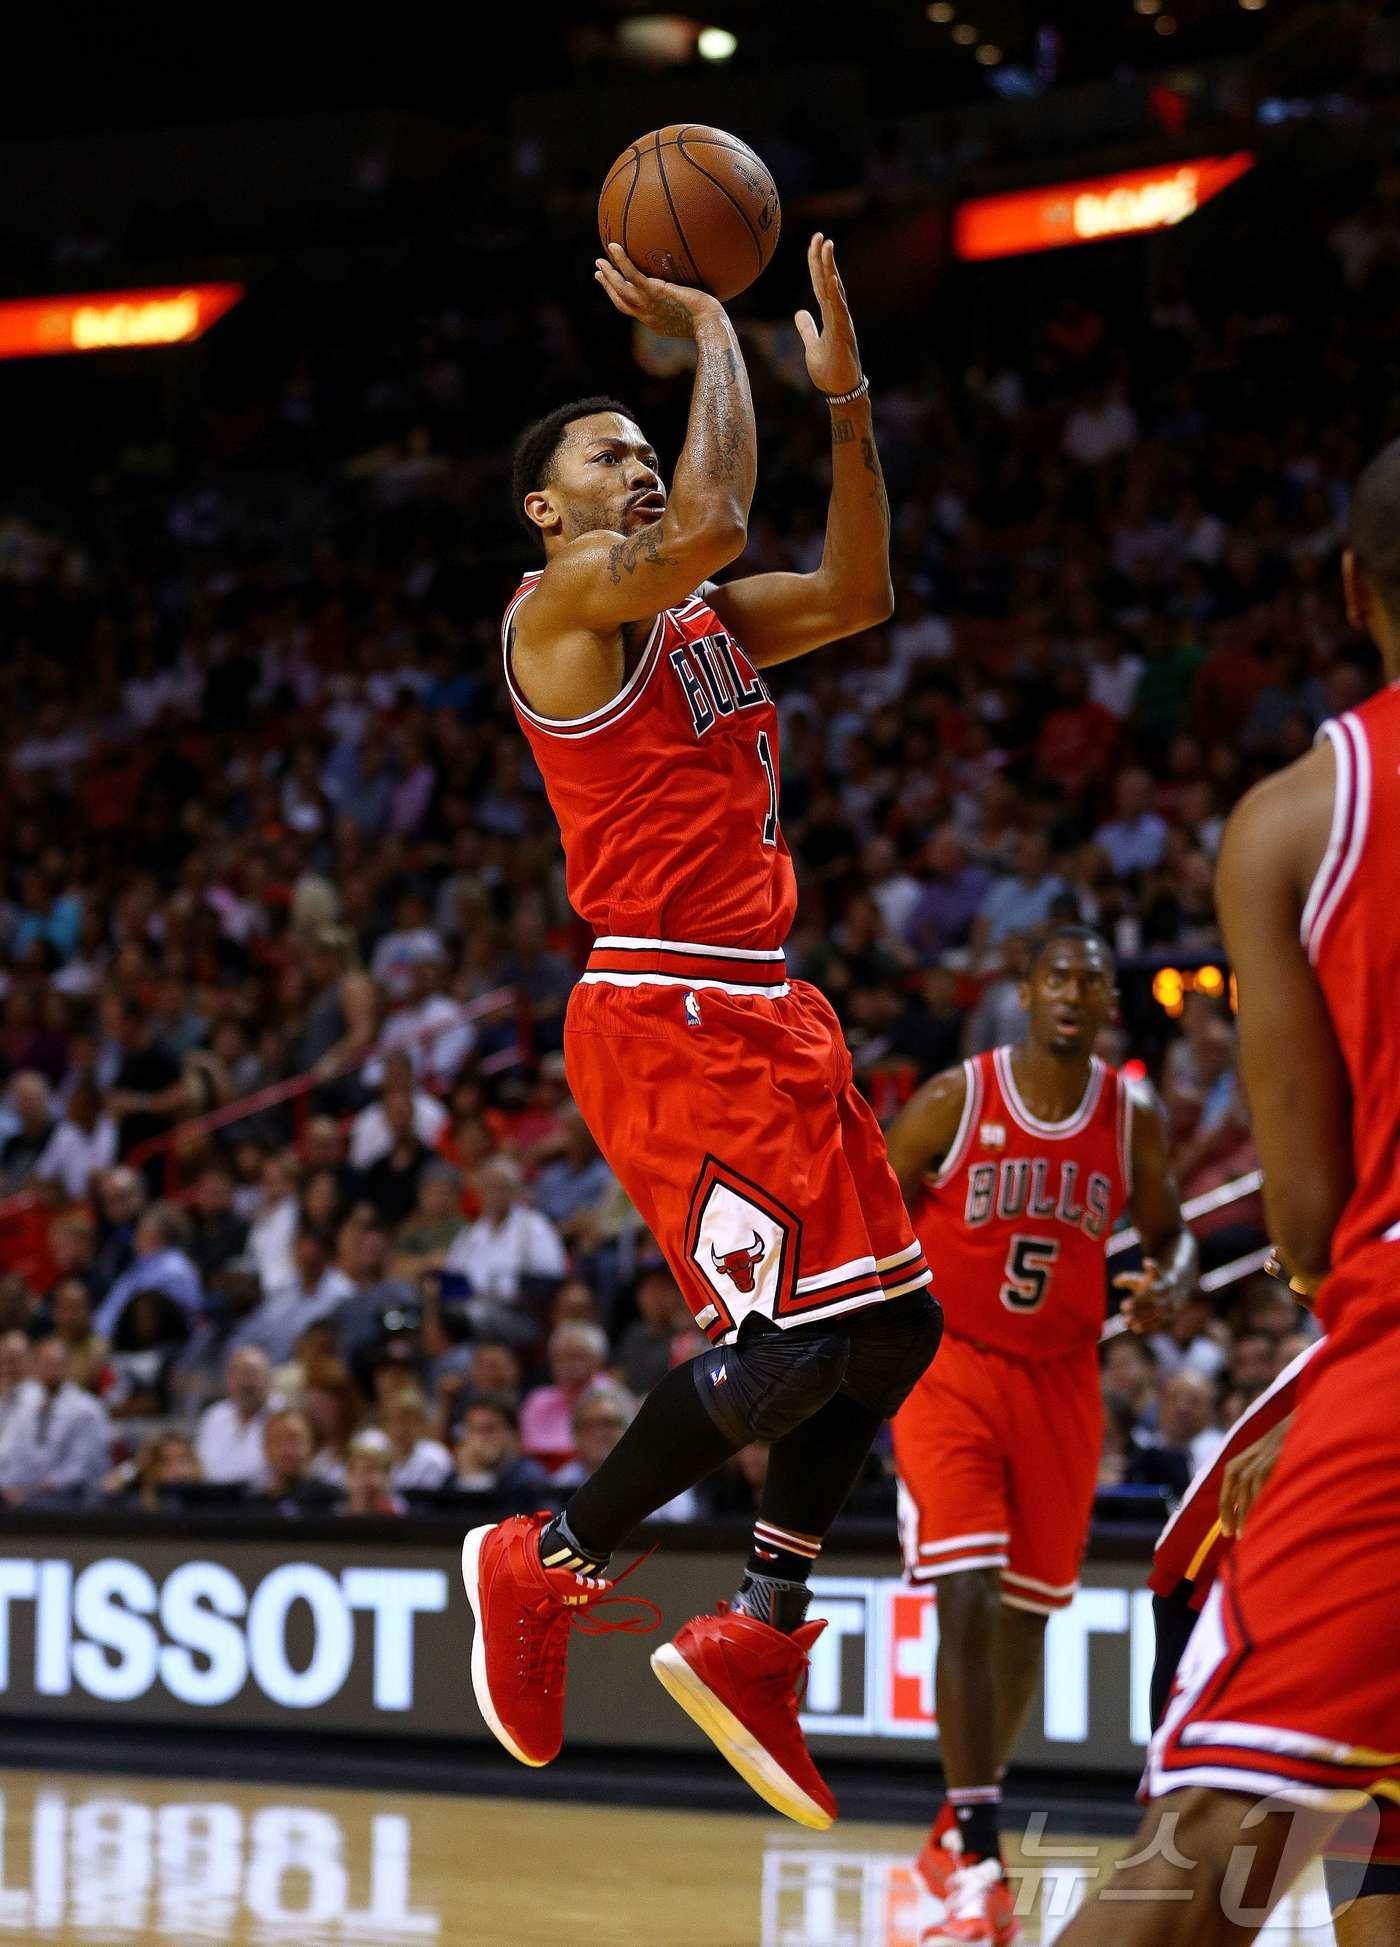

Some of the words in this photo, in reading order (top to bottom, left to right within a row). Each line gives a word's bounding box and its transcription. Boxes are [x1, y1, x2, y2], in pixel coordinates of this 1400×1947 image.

[757, 731, 777, 846] 1
[964, 1157, 1112, 1241] BULLS
[999, 1233, 1060, 1315] 5
